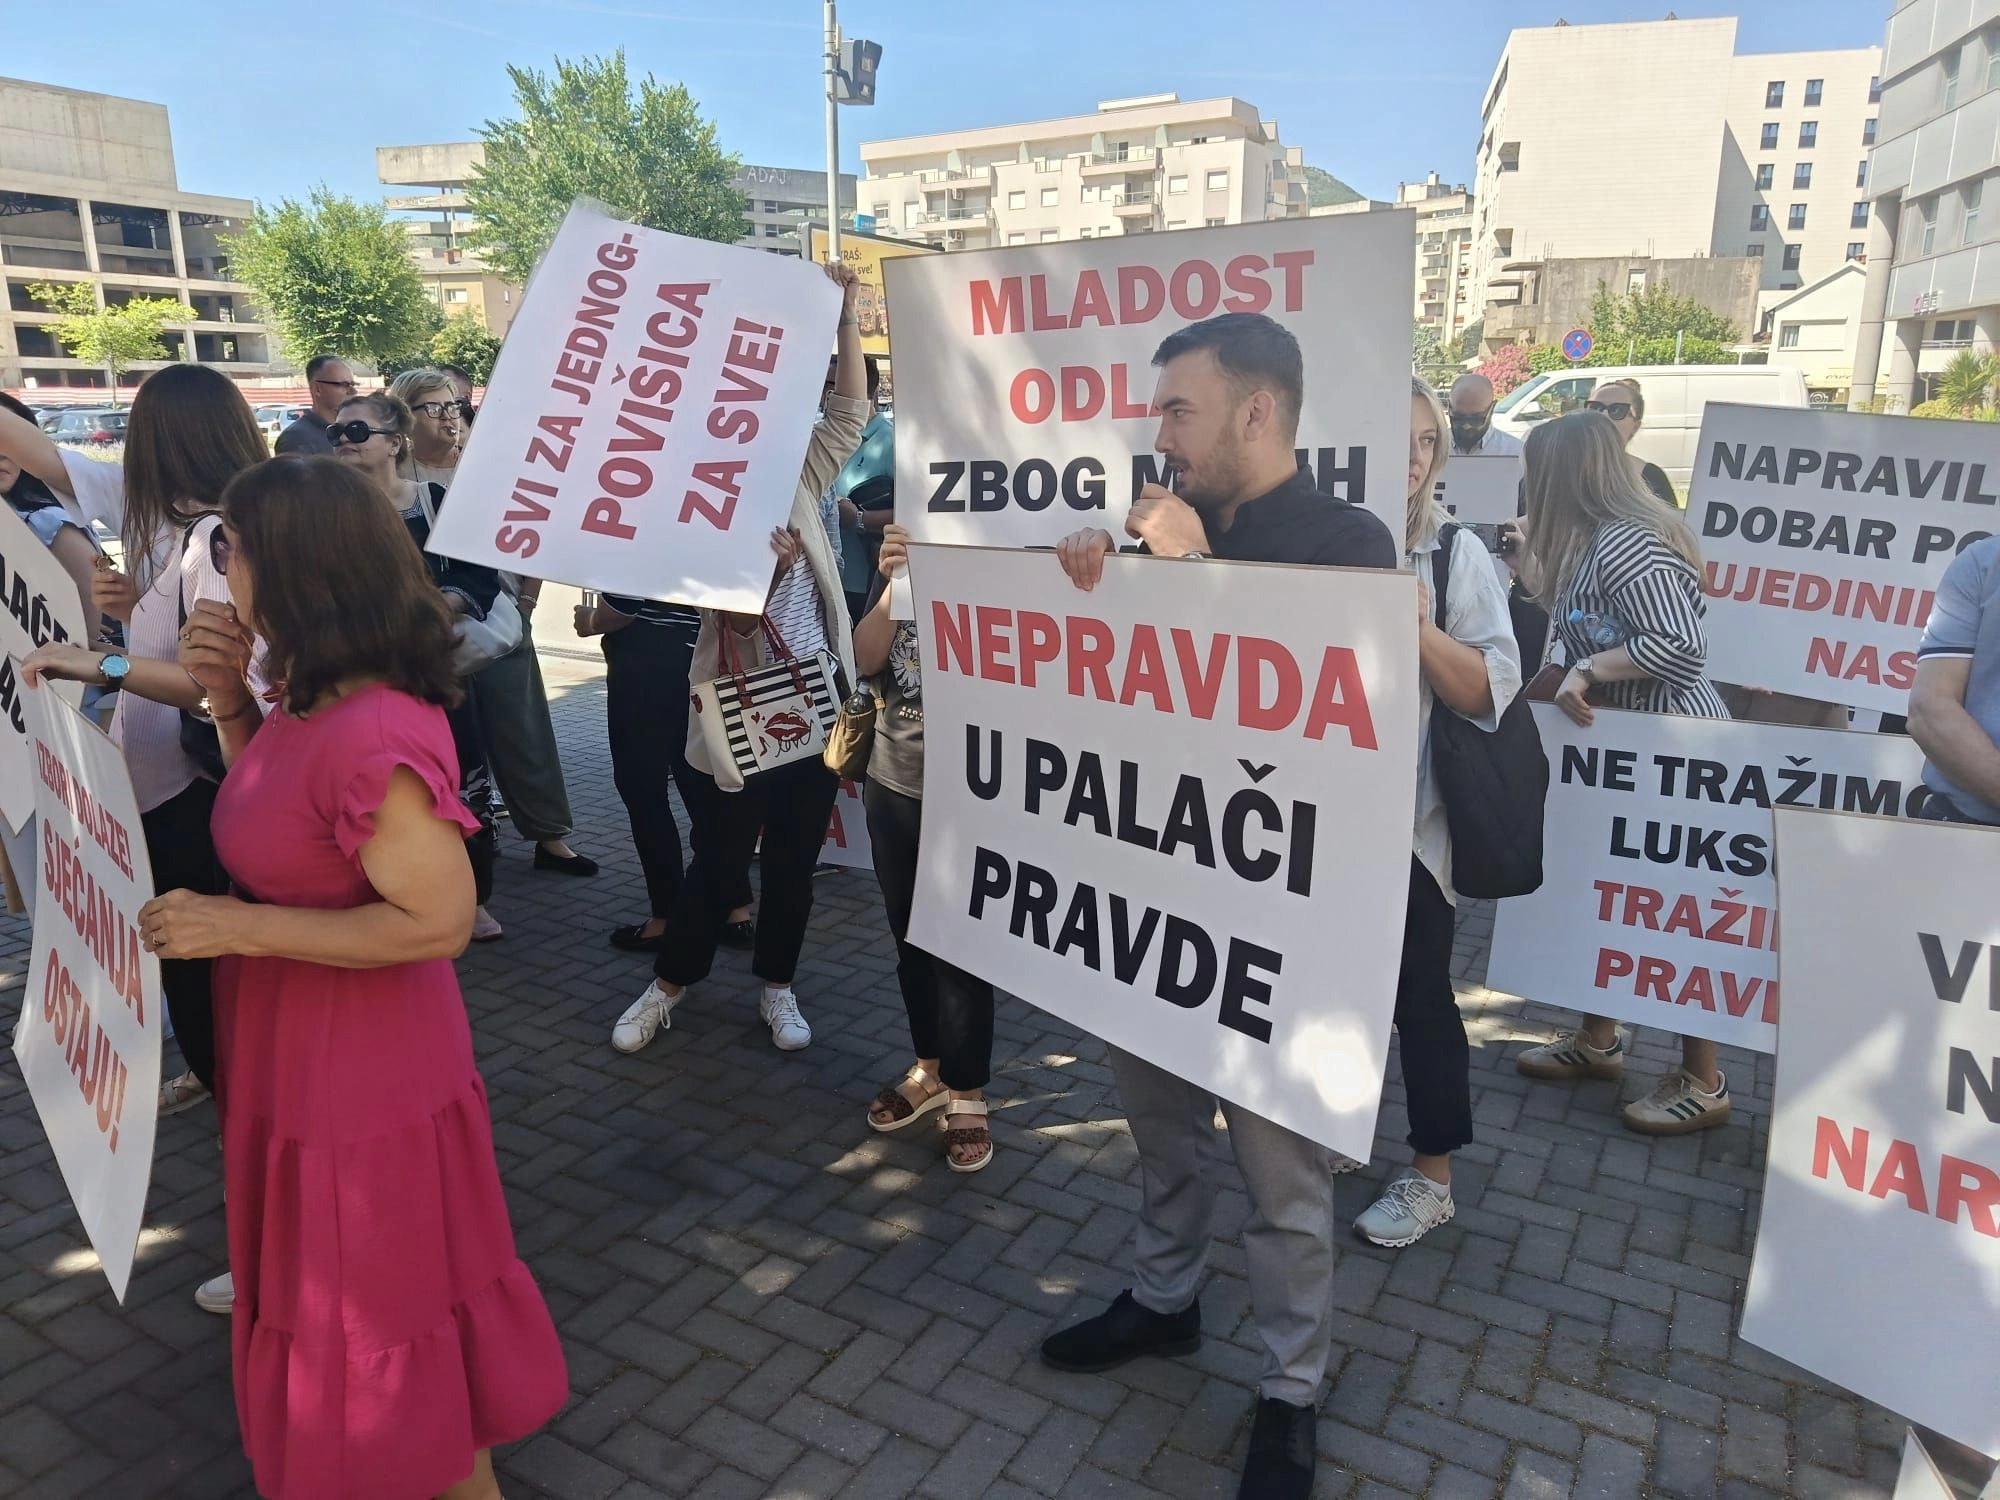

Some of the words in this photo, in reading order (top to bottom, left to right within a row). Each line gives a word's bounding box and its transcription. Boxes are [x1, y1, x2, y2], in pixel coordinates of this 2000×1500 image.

[551, 233, 639, 406] JEDNOG-
[969, 250, 1315, 335] MLADOST
[580, 283, 711, 540] POVIŠICA
[706, 317, 784, 445] SVE!
[1009, 363, 1162, 424] ODL
[524, 416, 583, 473] ZA
[677, 460, 749, 531] ZA
[927, 456, 1106, 513] ZBOG
[1708, 441, 2000, 505] NAPRAVIL
[495, 478, 559, 559] SVI
[1702, 501, 1896, 560] DOBAR
[931, 600, 1379, 751] NEPRAVDA
[36, 738, 73, 814] IZBORI
[72, 776, 135, 883] DOLAZE!
[966, 724, 1002, 800] U
[1024, 737, 1317, 898] PALAČI
[1560, 745, 1638, 792] NE
[1609, 816, 1776, 876] LUKS
[44, 818, 144, 1029] SJEĆANJA
[968, 846, 1284, 1044] PRAVDE
[43, 947, 128, 1155] OSTAJU!
[1812, 1115, 2000, 1238] NAR
